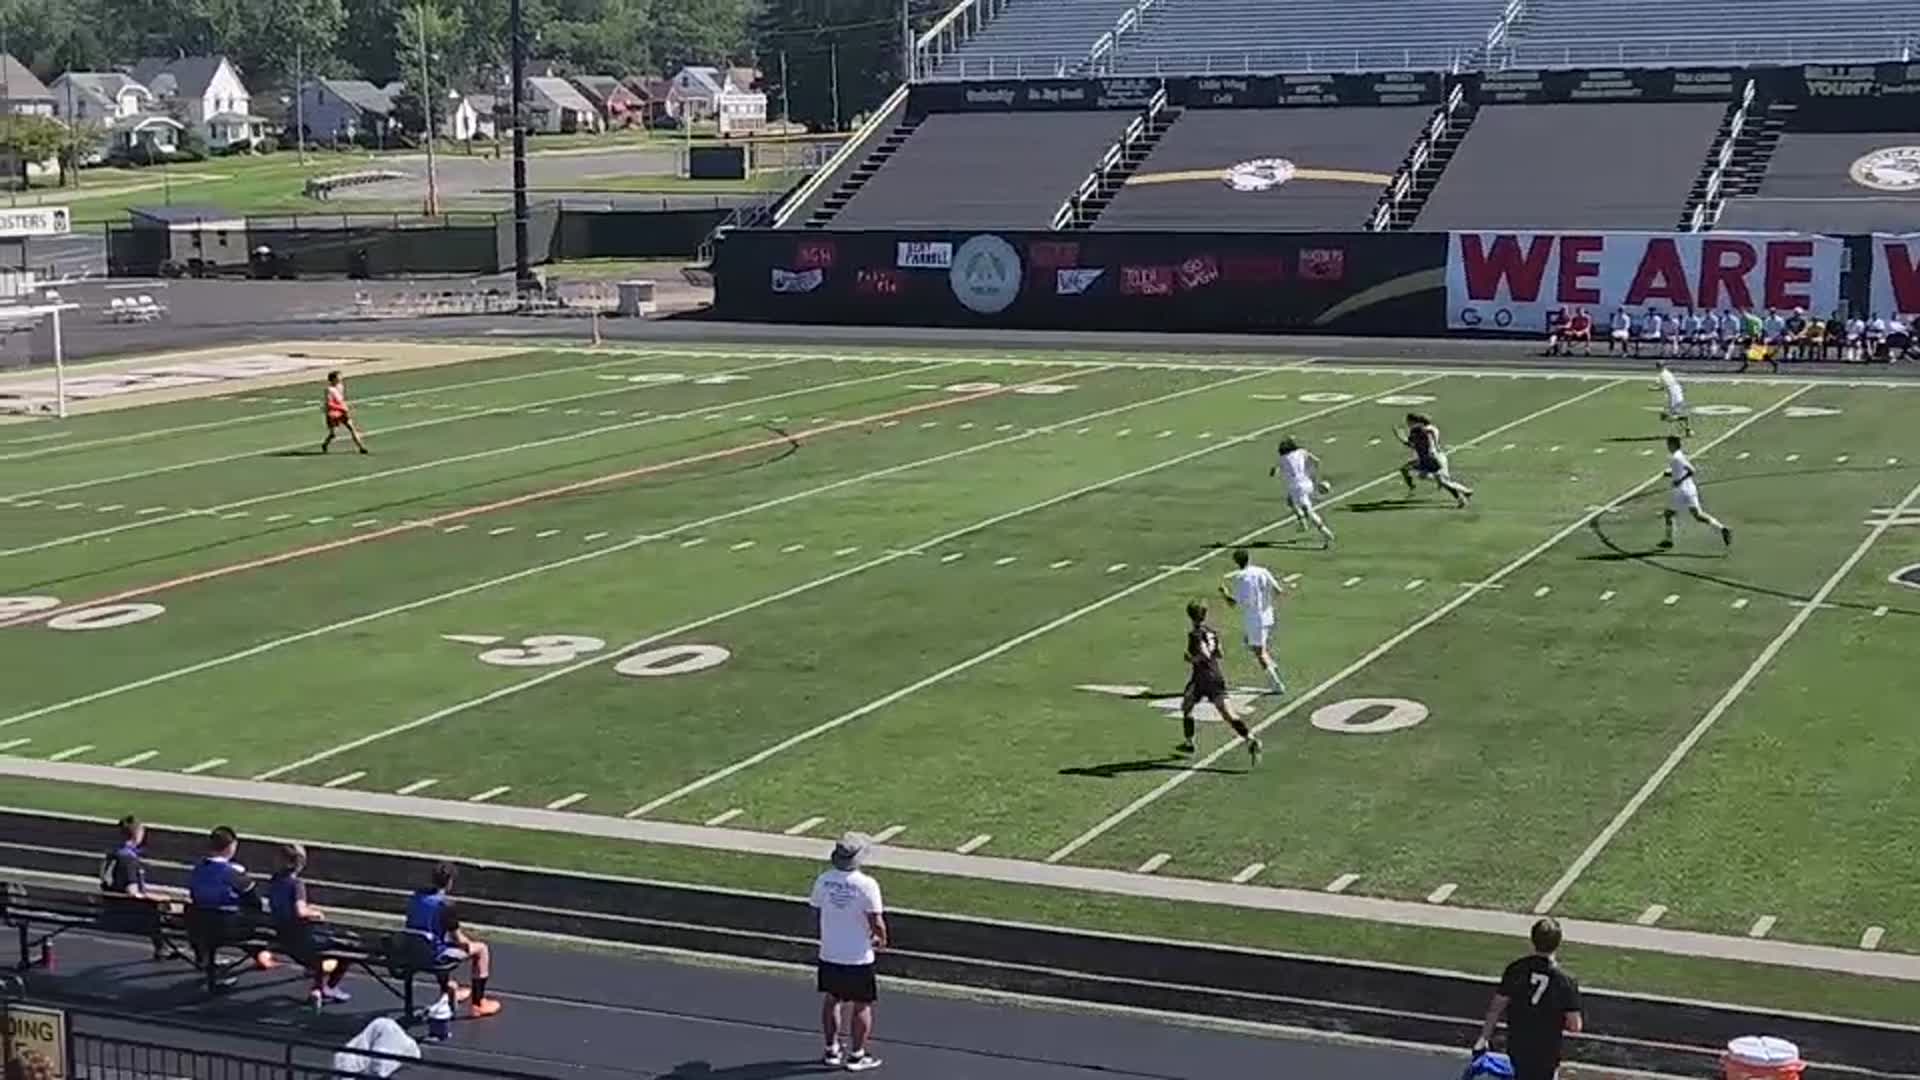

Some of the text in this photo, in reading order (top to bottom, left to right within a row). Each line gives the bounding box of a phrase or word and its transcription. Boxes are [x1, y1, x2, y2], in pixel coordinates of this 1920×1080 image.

[1460, 233, 1604, 304] WE
[1624, 237, 1815, 311] ARE
[1531, 973, 1549, 1005] 7
